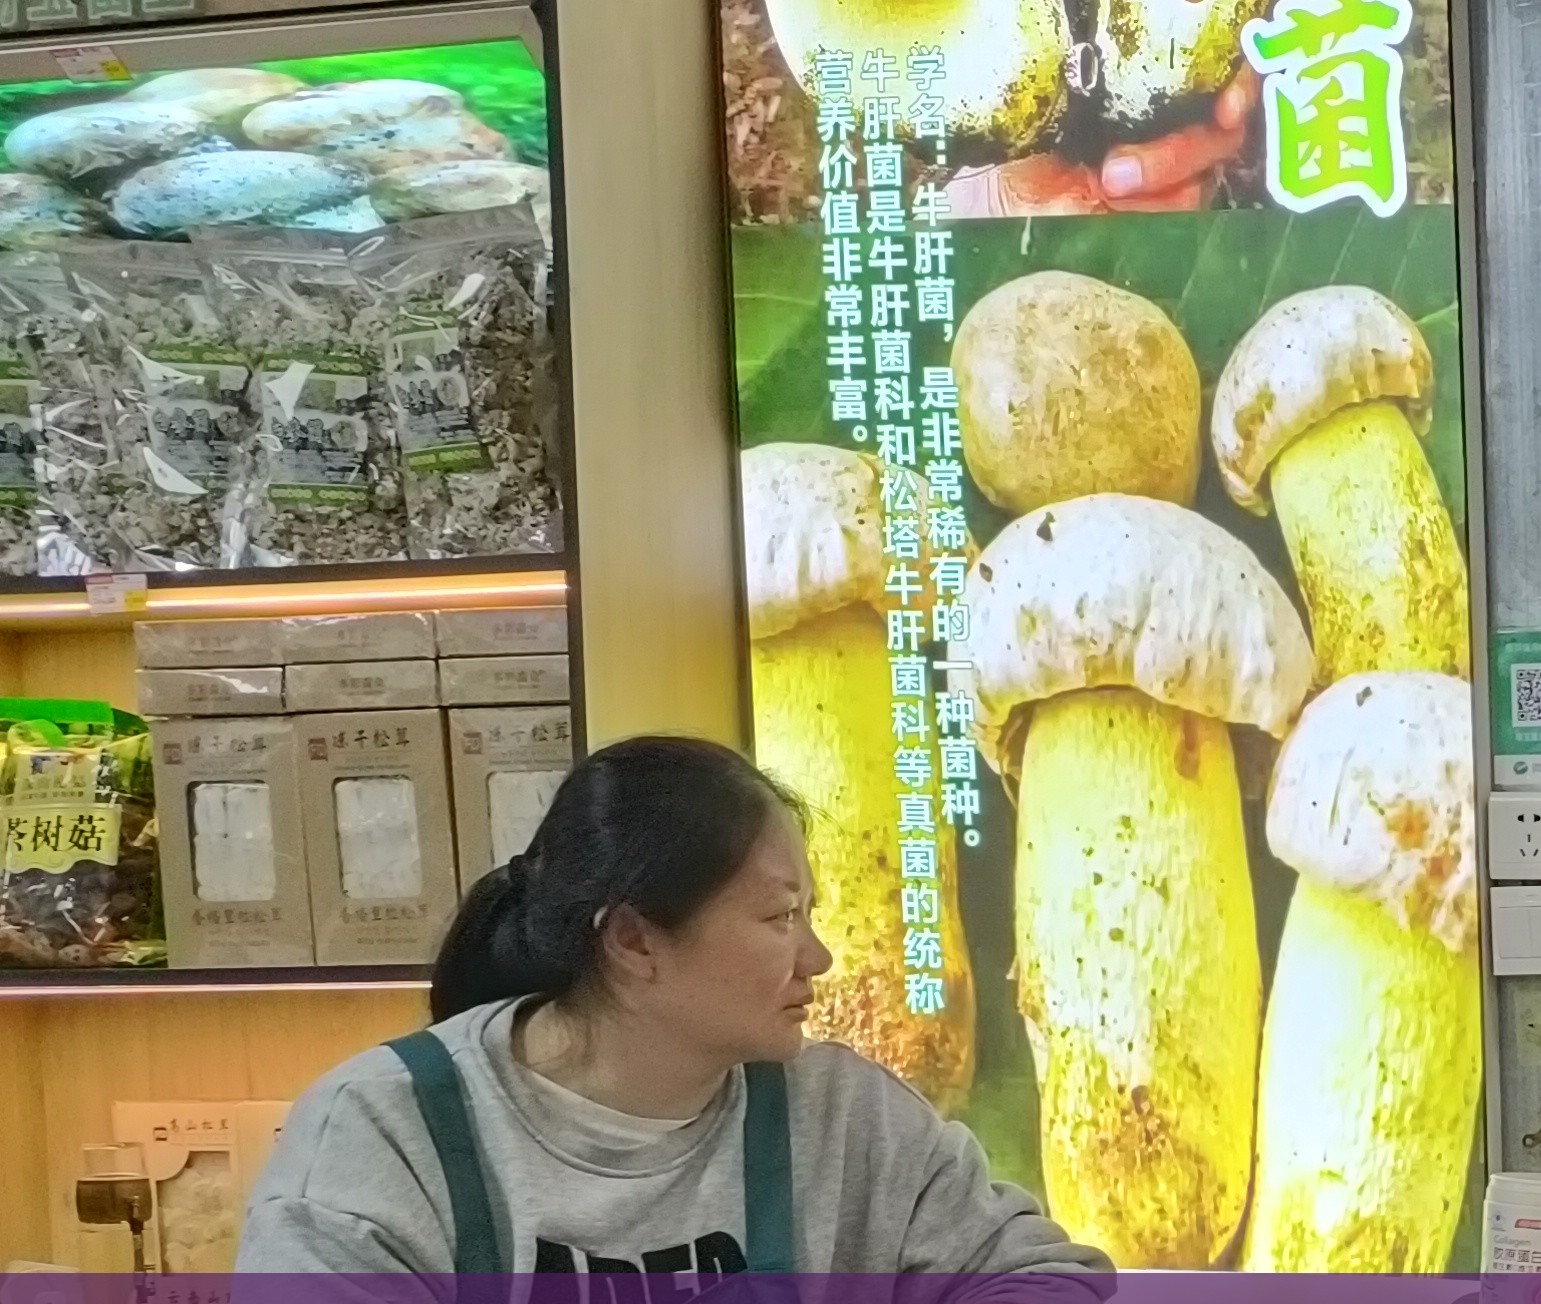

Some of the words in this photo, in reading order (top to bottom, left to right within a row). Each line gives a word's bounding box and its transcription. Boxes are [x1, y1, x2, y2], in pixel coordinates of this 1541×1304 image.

[815, 49, 869, 443] 营养价值非常丰富。
[1243, 0, 1410, 215] 菌
[861, 47, 945, 1016] 牛肝菌是牛肝菌科和松塔牛肝菌科等真菌的统称
[906, 44, 983, 850] 学名：牛肝菌，是非常稀有的一种菌种。
